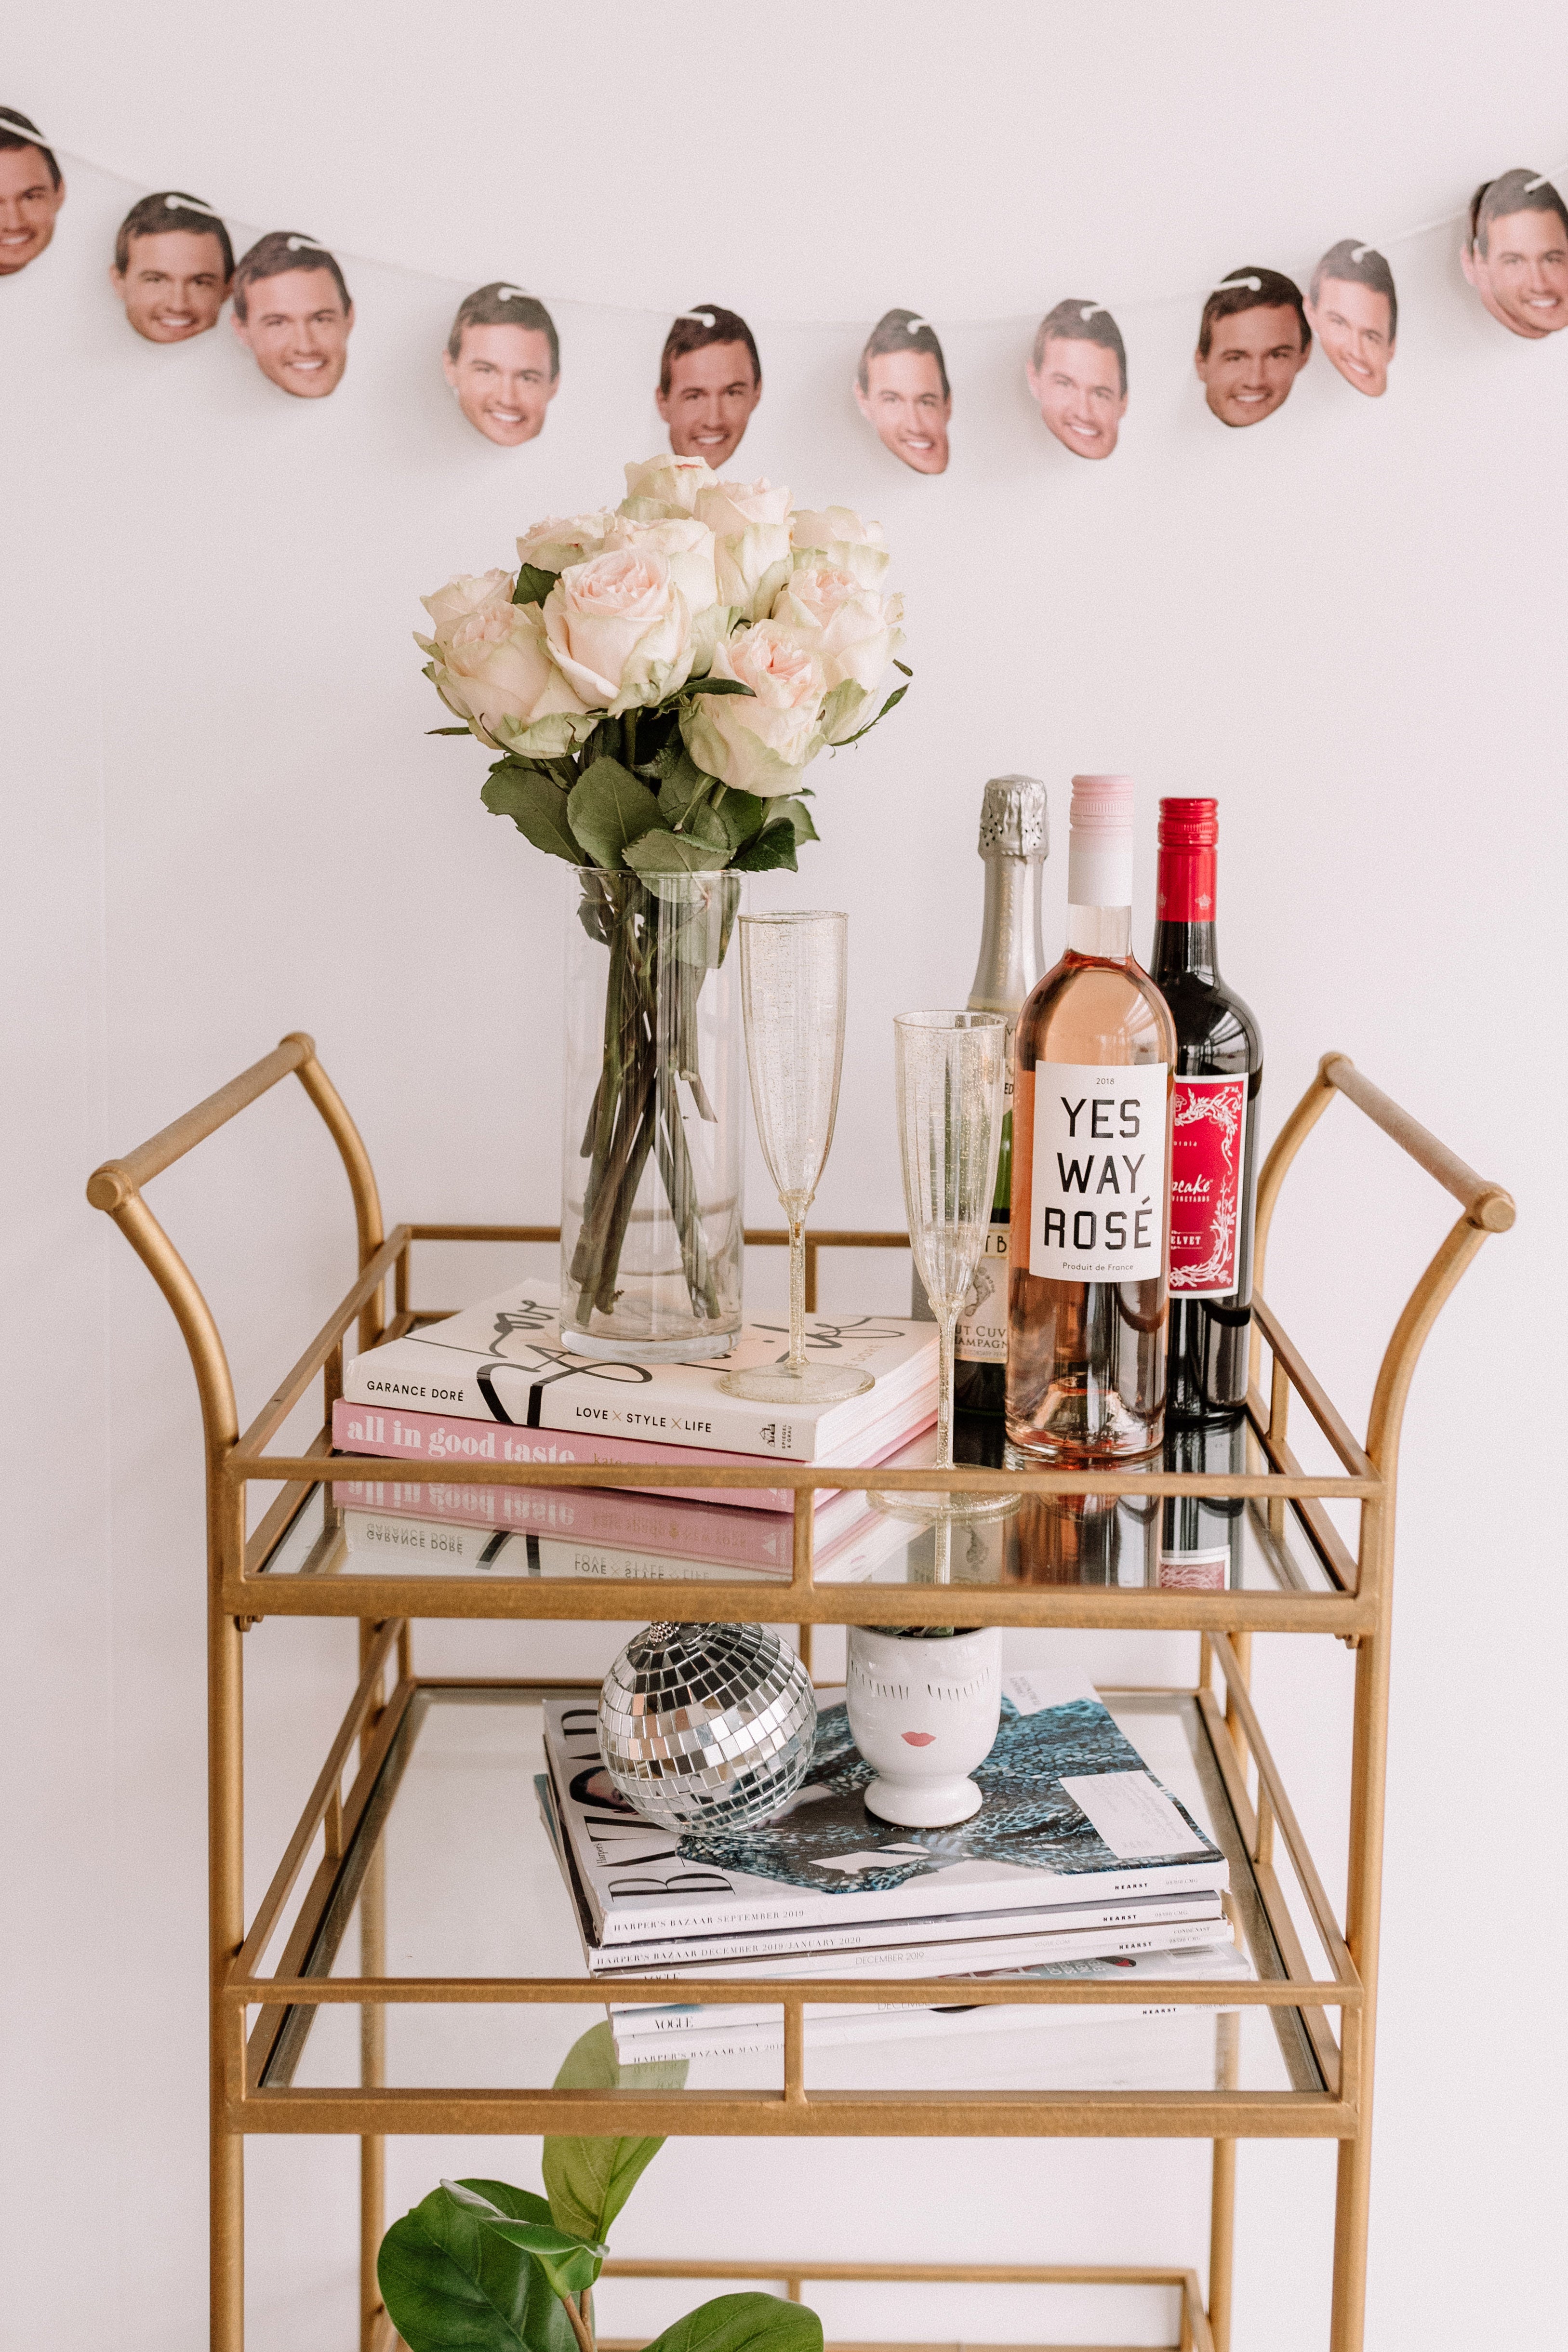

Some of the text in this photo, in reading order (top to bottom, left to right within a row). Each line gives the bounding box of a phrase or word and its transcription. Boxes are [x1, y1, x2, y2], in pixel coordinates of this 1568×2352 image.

[1060, 1096, 1141, 1139] YES
[1057, 1152, 1146, 1195] WAY
[1044, 1196, 1153, 1250] ROSÉ
[1170, 1236, 1201, 1245] ELVET
[1063, 1262, 1092, 1271] Produit
[976, 1326, 1007, 1338] CUV
[367, 1381, 464, 1401] GARANCE DORÉ
[576, 1407, 608, 1420] LOVE
[626, 1413, 666, 1427] STYLE
[685, 1421, 712, 1433] LIFE
[347, 1415, 576, 1463] all in good taste
[593, 1843, 608, 1864] Harper's
[614, 1910, 804, 1931] HARPER'S BAZAAR SEPTEMBER 2019
[597, 1954, 649, 1965] HARPER'S
[653, 1950, 697, 1960] BAZAAR
[701, 1945, 759, 1956] DECEMBER
[839, 1937, 861, 1945] 2020
[855, 1953, 904, 1965] DECEMBER
[906, 1952, 924, 1961] 2019
[655, 2017, 694, 2030] VOGUE
[691, 2048, 734, 2058] BAZAAR
[739, 2046, 759, 2054] MAY
